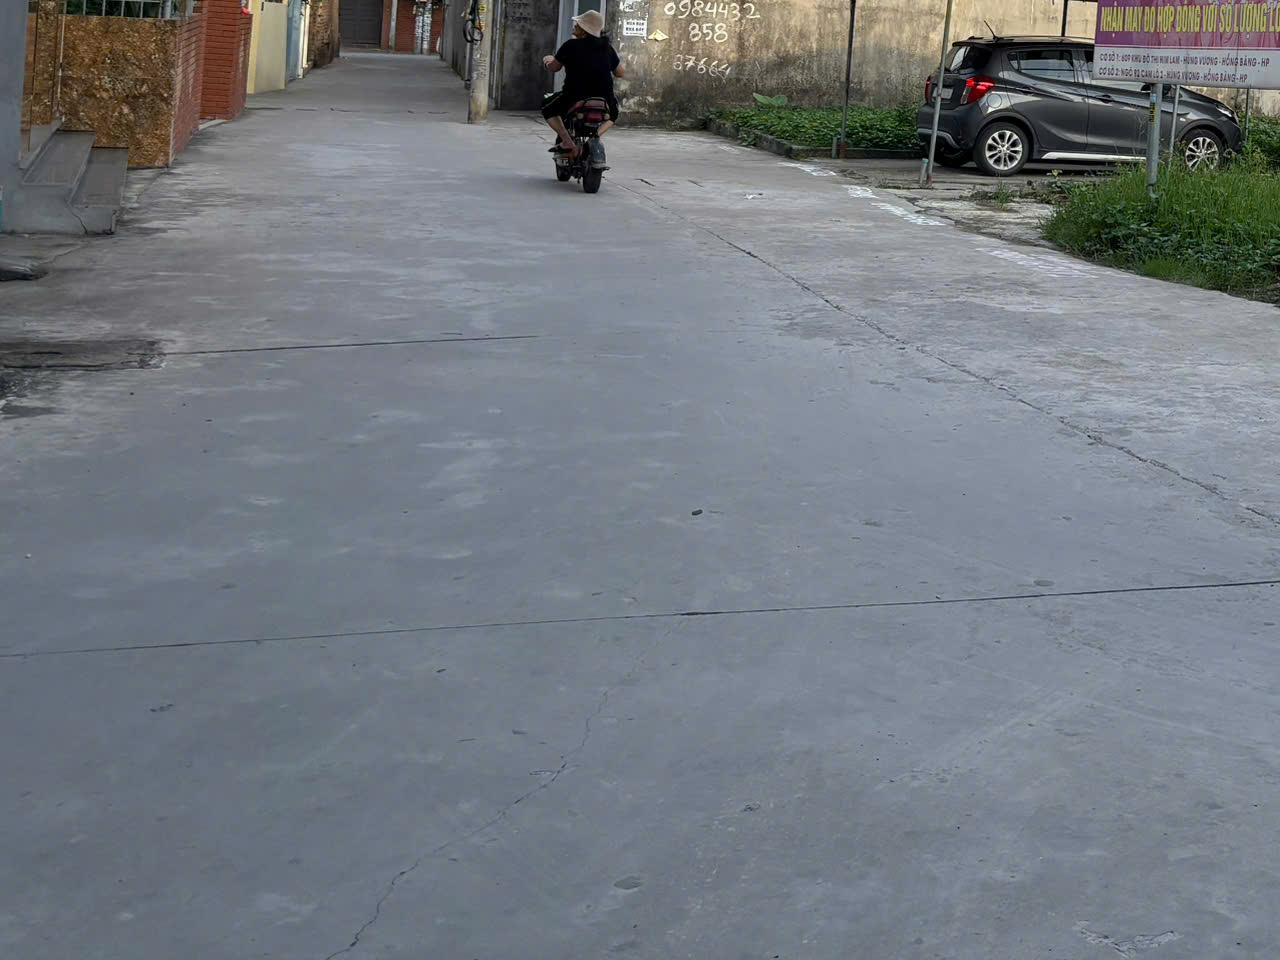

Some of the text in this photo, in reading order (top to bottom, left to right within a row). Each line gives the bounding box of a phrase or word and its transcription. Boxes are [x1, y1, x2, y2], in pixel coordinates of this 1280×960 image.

[664, 0, 760, 20] 0984432
[1100, 0, 1124, 38] NHẬN
[1124, 5, 1143, 32] MAY
[1143, 5, 1156, 32] ĐO
[1157, 3, 1175, 38] HỢP
[1202, 1, 1218, 32] VỚI
[1234, 1, 1267, 38] LƯỢNG
[689, 23, 728, 43] 858
[1261, 57, 1270, 67] HP
[1239, 73, 1248, 83] HP
